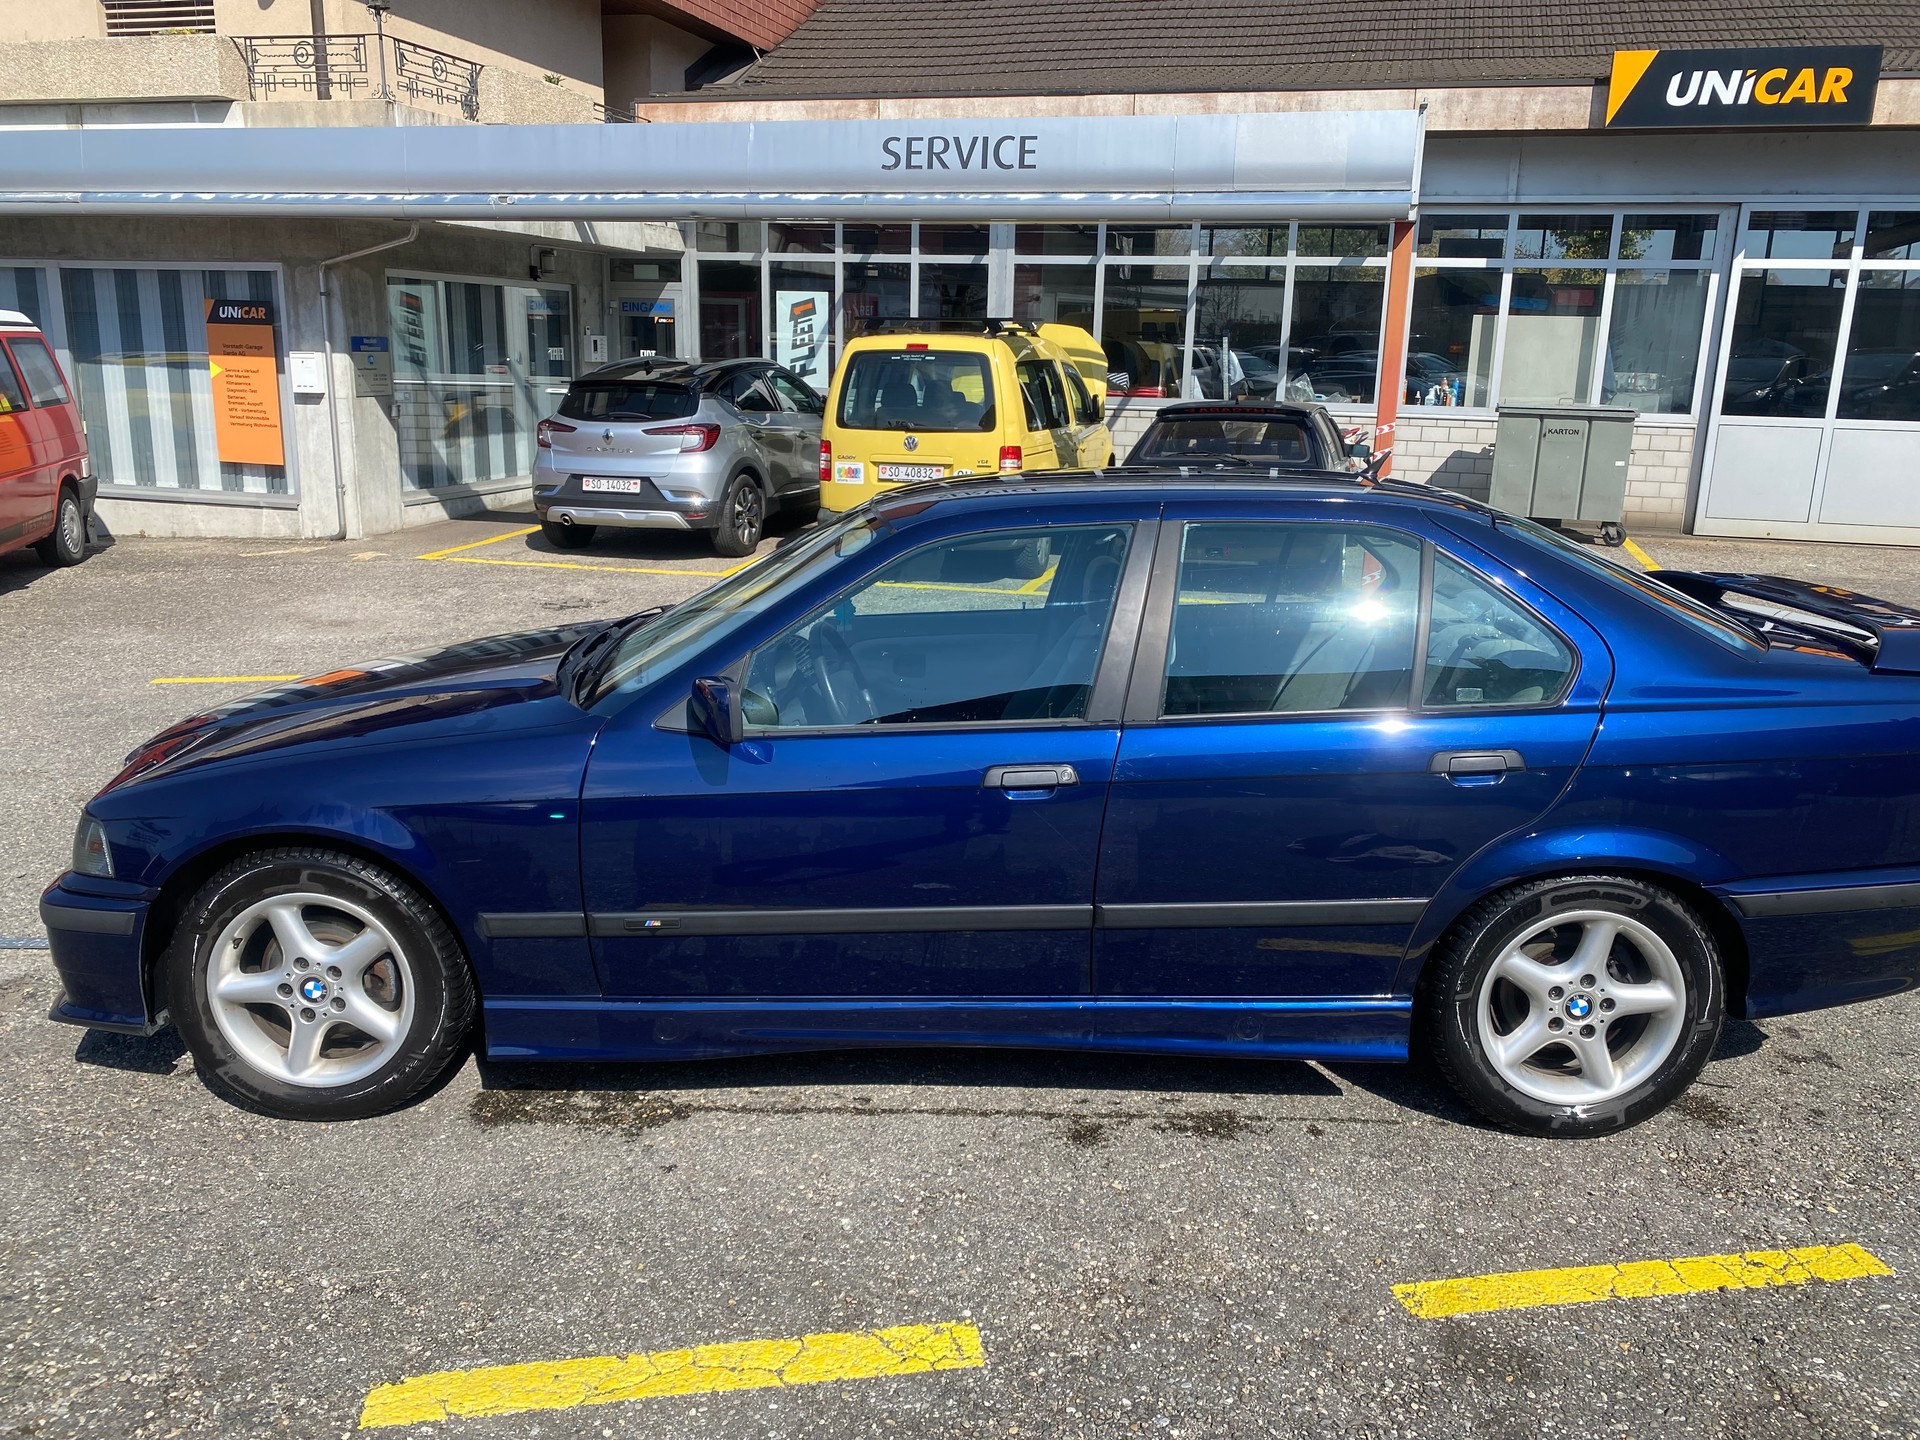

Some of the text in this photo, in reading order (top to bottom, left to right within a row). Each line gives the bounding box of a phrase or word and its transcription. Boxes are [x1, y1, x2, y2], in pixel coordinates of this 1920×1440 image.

[881, 135, 1038, 170] SERVICE
[621, 302, 674, 314] EINGANG
[1547, 428, 1580, 436] KARTON
[586, 446, 634, 454] CAPTUR
